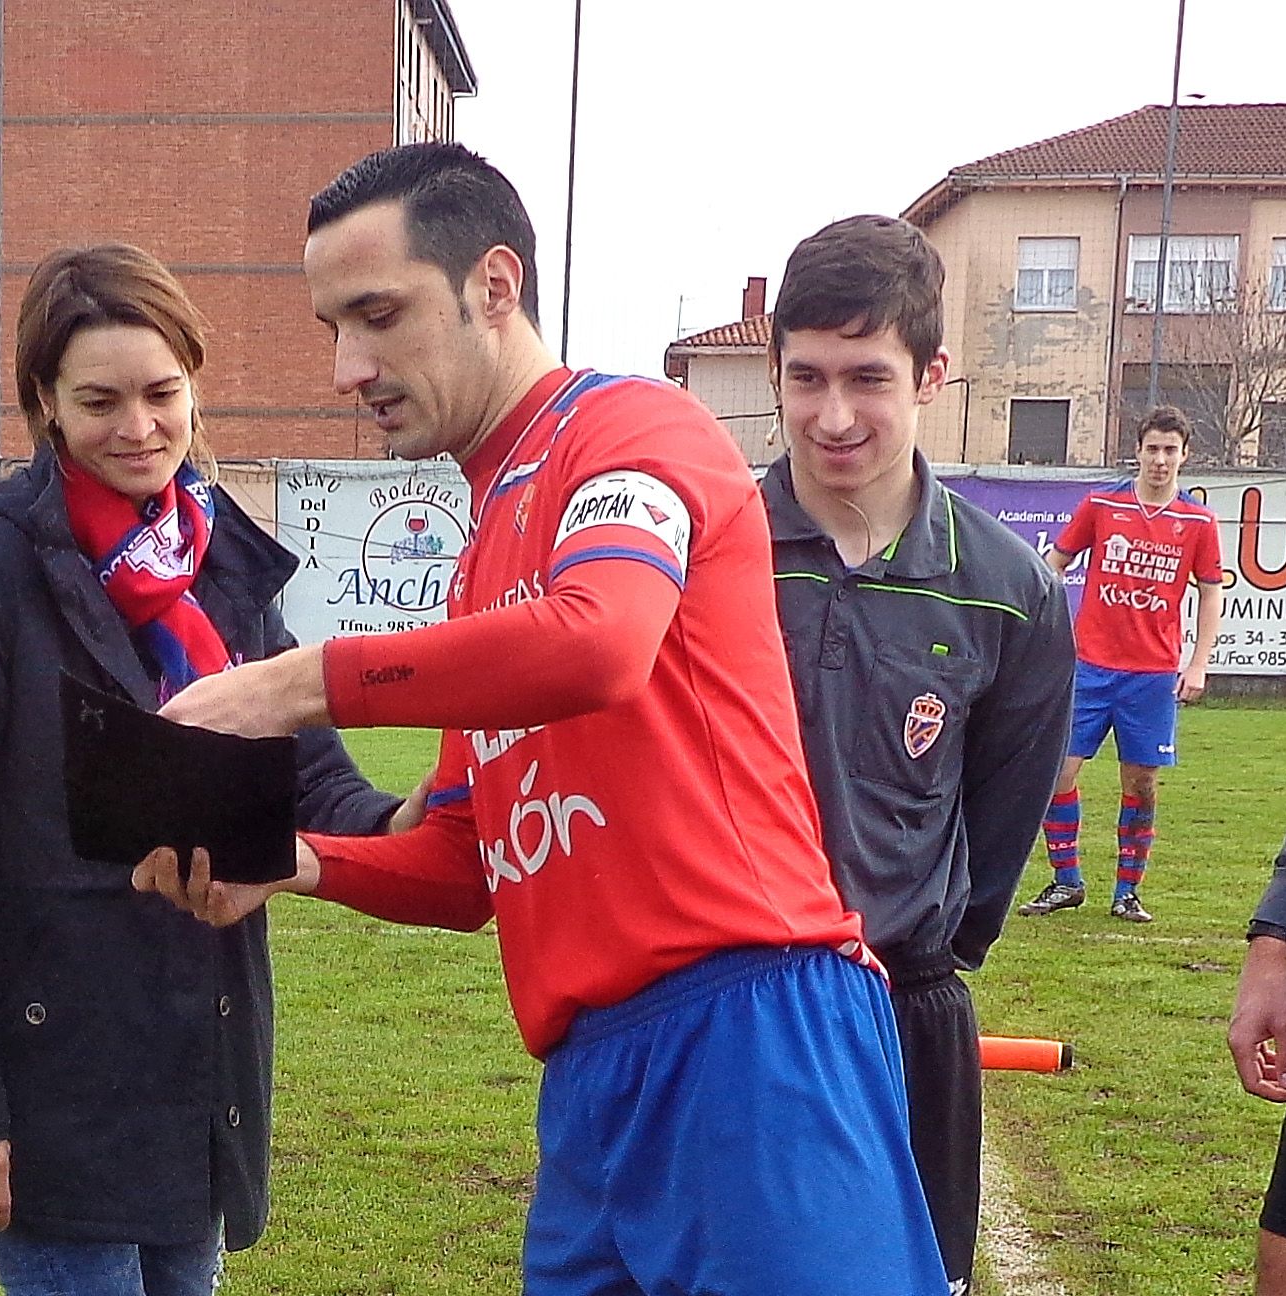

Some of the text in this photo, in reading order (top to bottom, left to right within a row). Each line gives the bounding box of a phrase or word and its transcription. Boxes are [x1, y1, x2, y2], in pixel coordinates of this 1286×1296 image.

[369, 475, 463, 509] Bodegas
[300, 498, 326, 512] Del
[566, 488, 635, 532] CAPITÁN
[997, 509, 1072, 523] Academia de
[1132, 539, 1183, 557] FACHADAS
[1130, 551, 1180, 571] GIJON
[1101, 559, 1177, 584] EL LLANO
[1244, 631, 1264, 646] 34
[1258, 652, 1286, 666] 985
